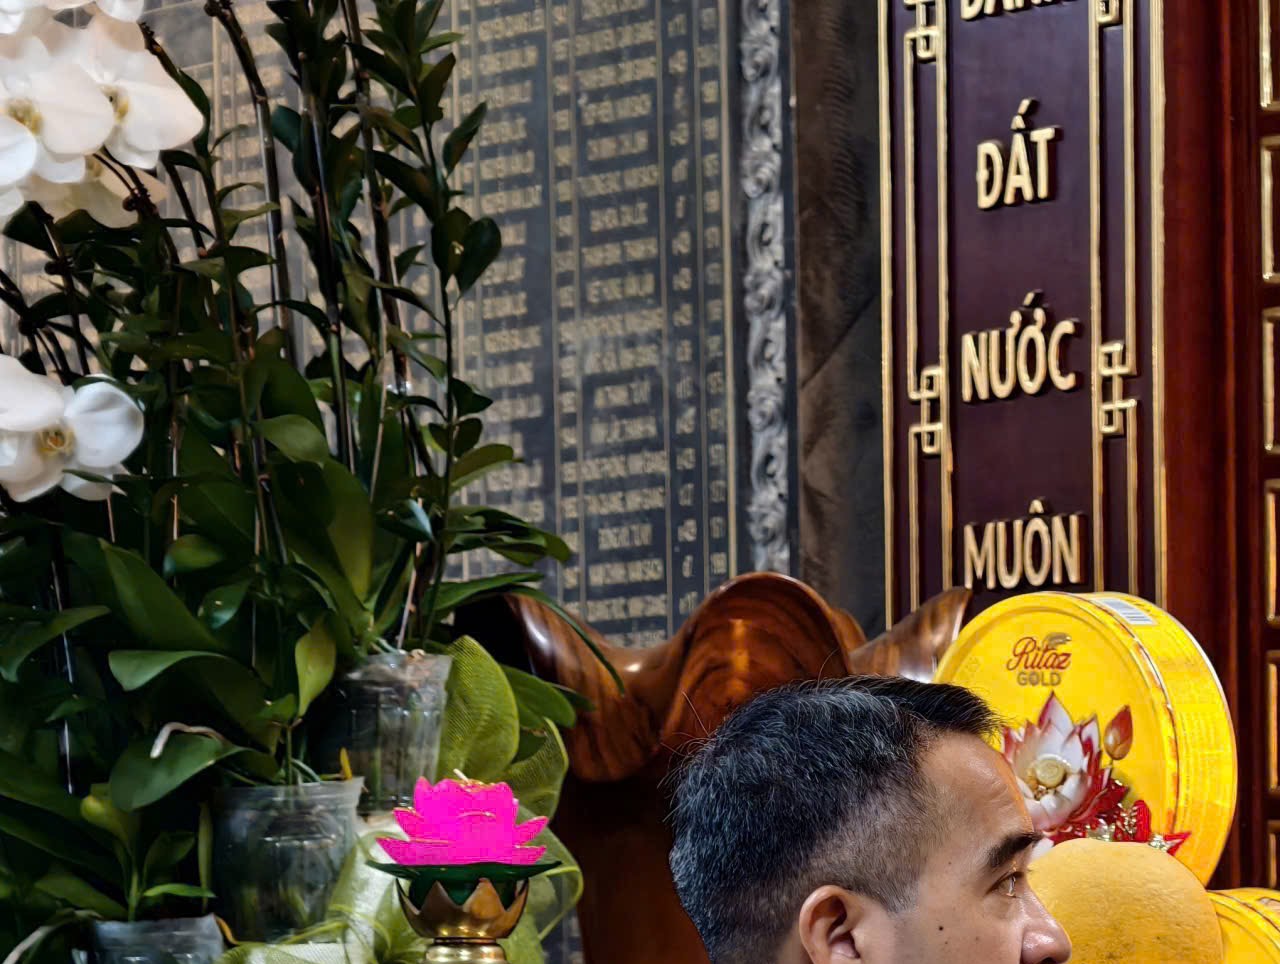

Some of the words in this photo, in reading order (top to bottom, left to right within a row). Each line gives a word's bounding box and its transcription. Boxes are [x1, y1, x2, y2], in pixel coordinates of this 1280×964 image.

[975, 98, 1058, 209] ĐẤT
[960, 290, 1081, 403] NƯỚC
[963, 497, 1084, 590] MUÔN
[1006, 636, 1072, 671] Ritaz
[1016, 672, 1062, 687] GOLD
